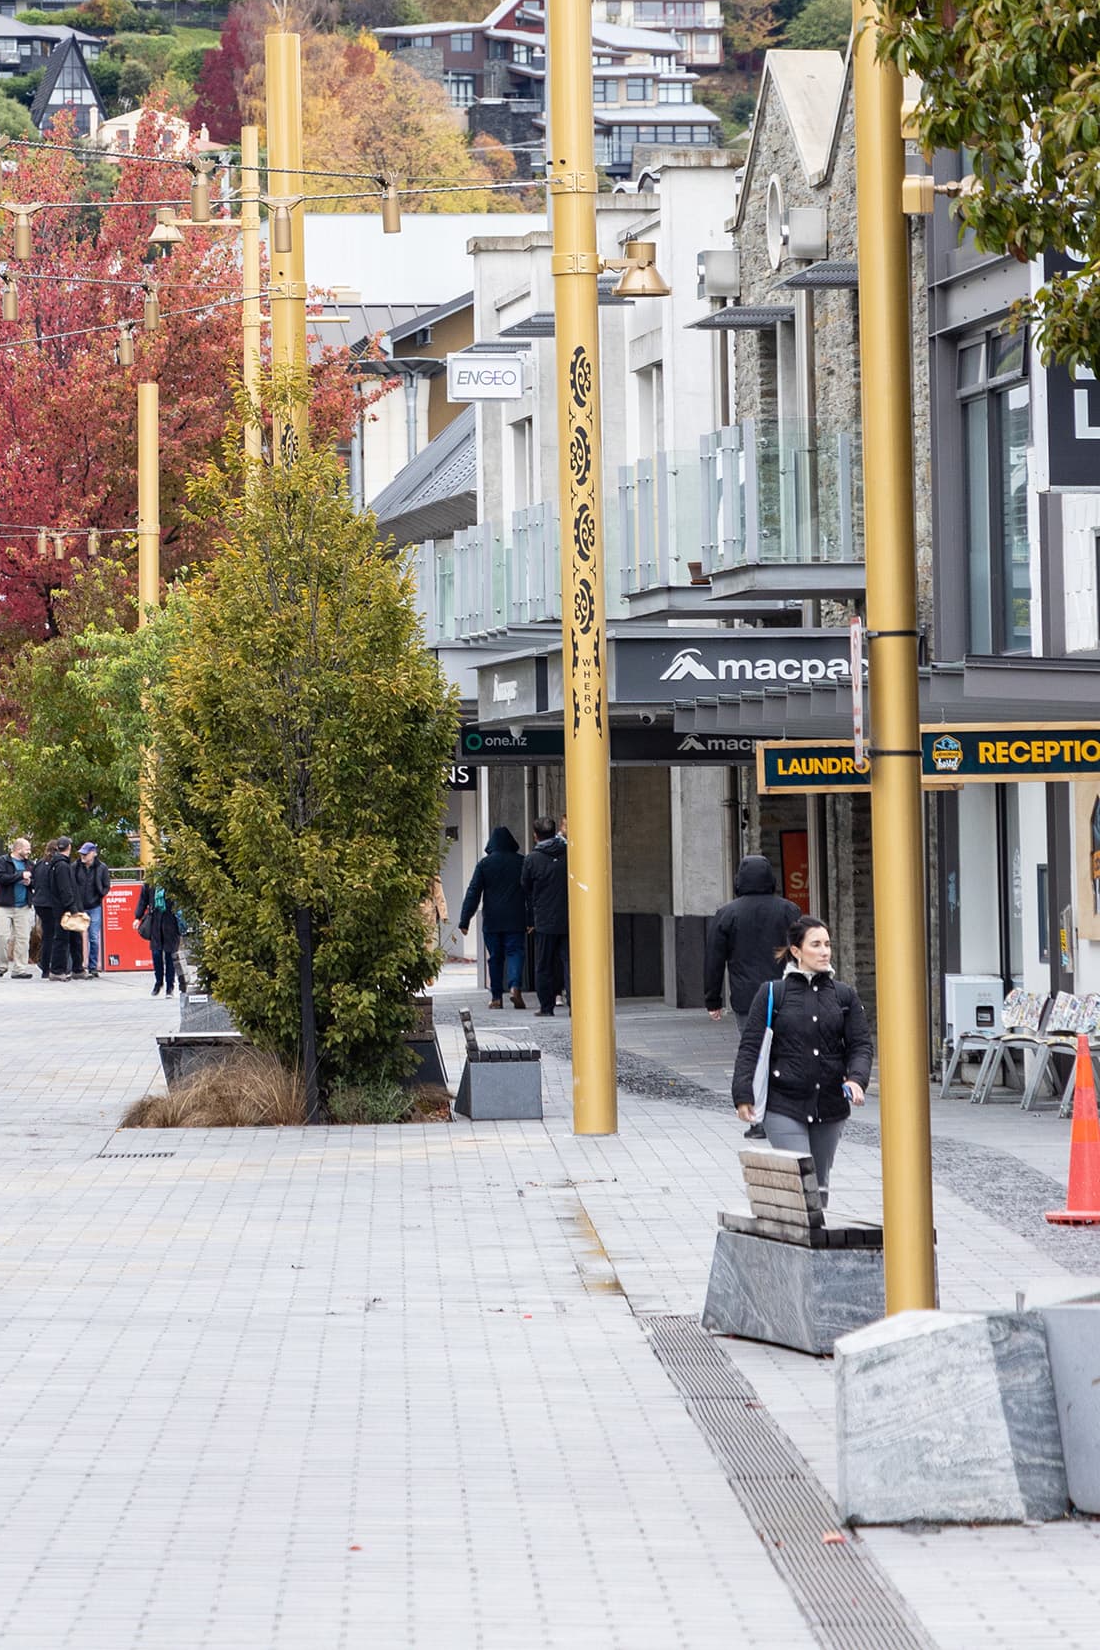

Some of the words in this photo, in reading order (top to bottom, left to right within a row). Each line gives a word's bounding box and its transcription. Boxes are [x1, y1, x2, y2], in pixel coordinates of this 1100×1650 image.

[457, 370, 517, 386] ENGEO
[582, 658, 592, 715] WHERO
[978, 739, 1100, 764] RECEPTIO
[777, 757, 871, 775] LAUNDRO
